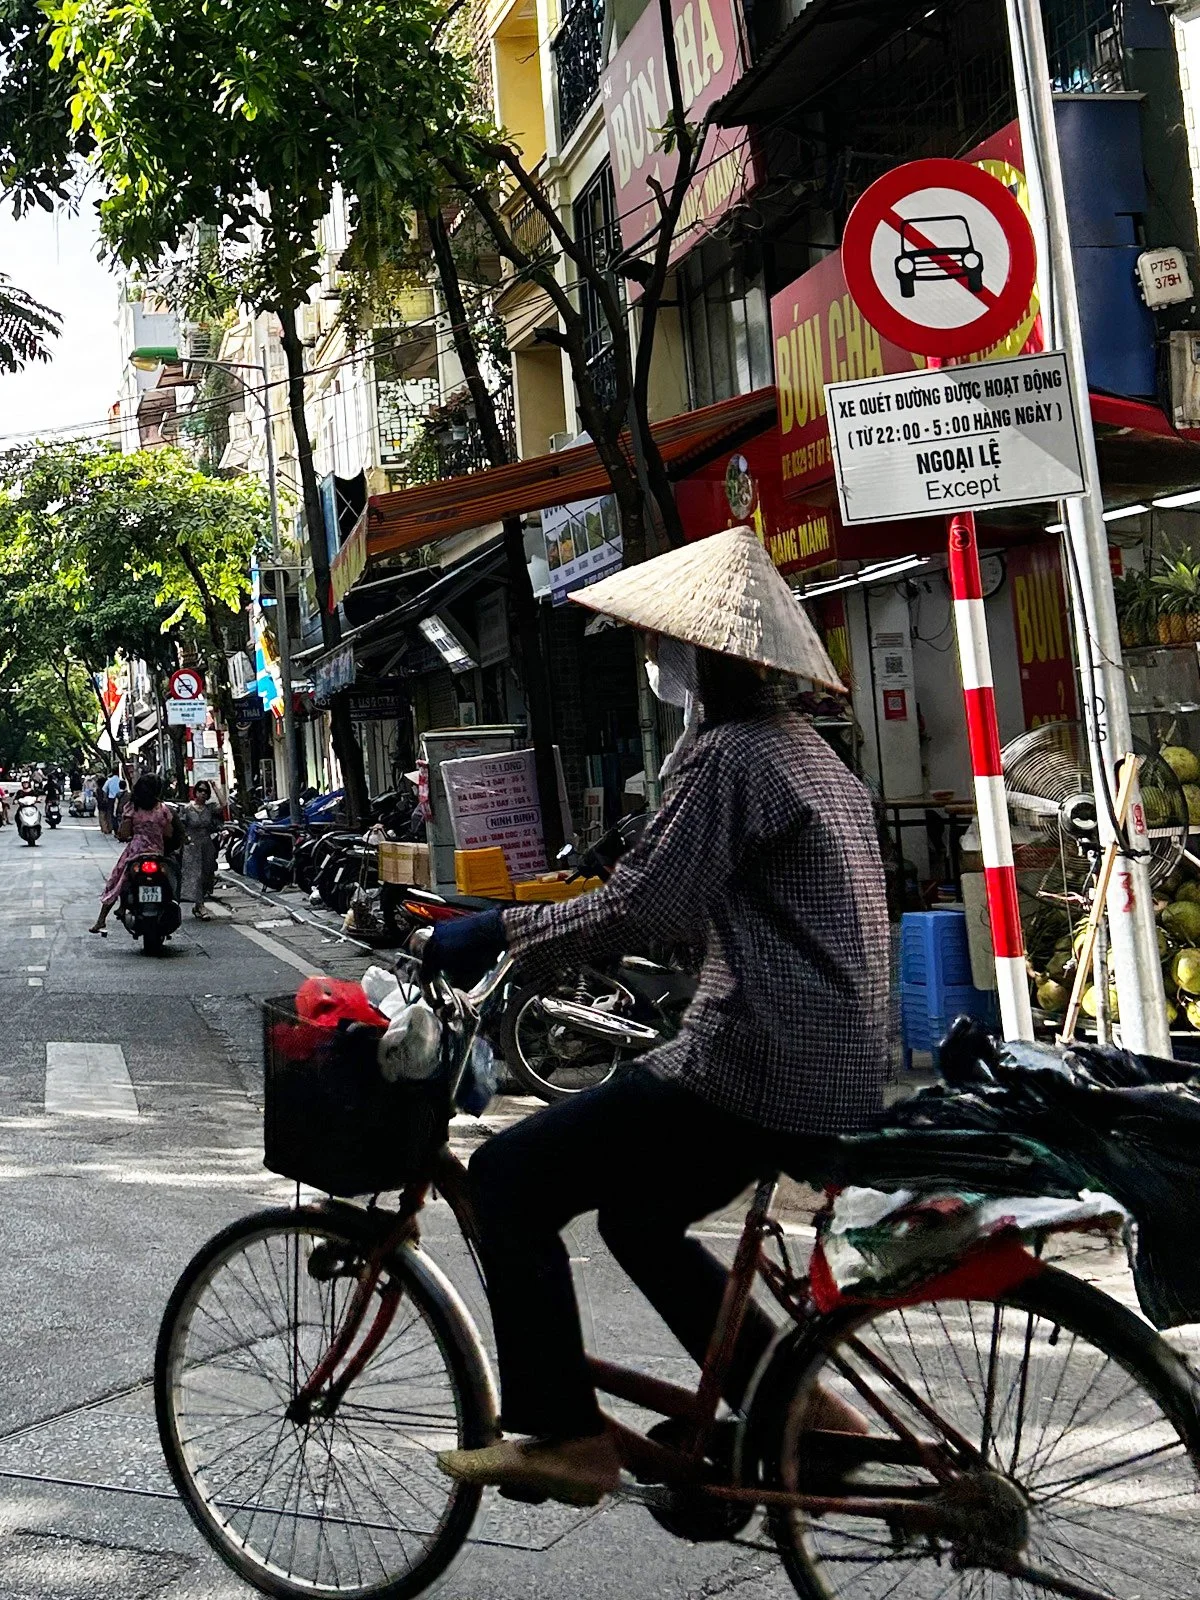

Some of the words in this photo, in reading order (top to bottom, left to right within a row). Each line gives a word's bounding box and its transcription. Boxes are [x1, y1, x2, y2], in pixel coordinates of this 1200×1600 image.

[1150, 258, 1177, 274] P755
[1155, 273, 1182, 289] 375H
[838, 400, 856, 418] XE
[859, 392, 891, 415] QUÉT
[895, 386, 941, 411] ĐƯỜNG
[944, 380, 982, 405] ĐƯỢC
[984, 375, 1020, 399] HOẠT
[1023, 369, 1062, 395] ĐỘNG
[973, 407, 1011, 431] HÀNG
[916, 443, 974, 475] NGOẠI
[979, 438, 1002, 469] LỆ
[926, 473, 1001, 500] Except
[490, 816, 512, 827] NINH
